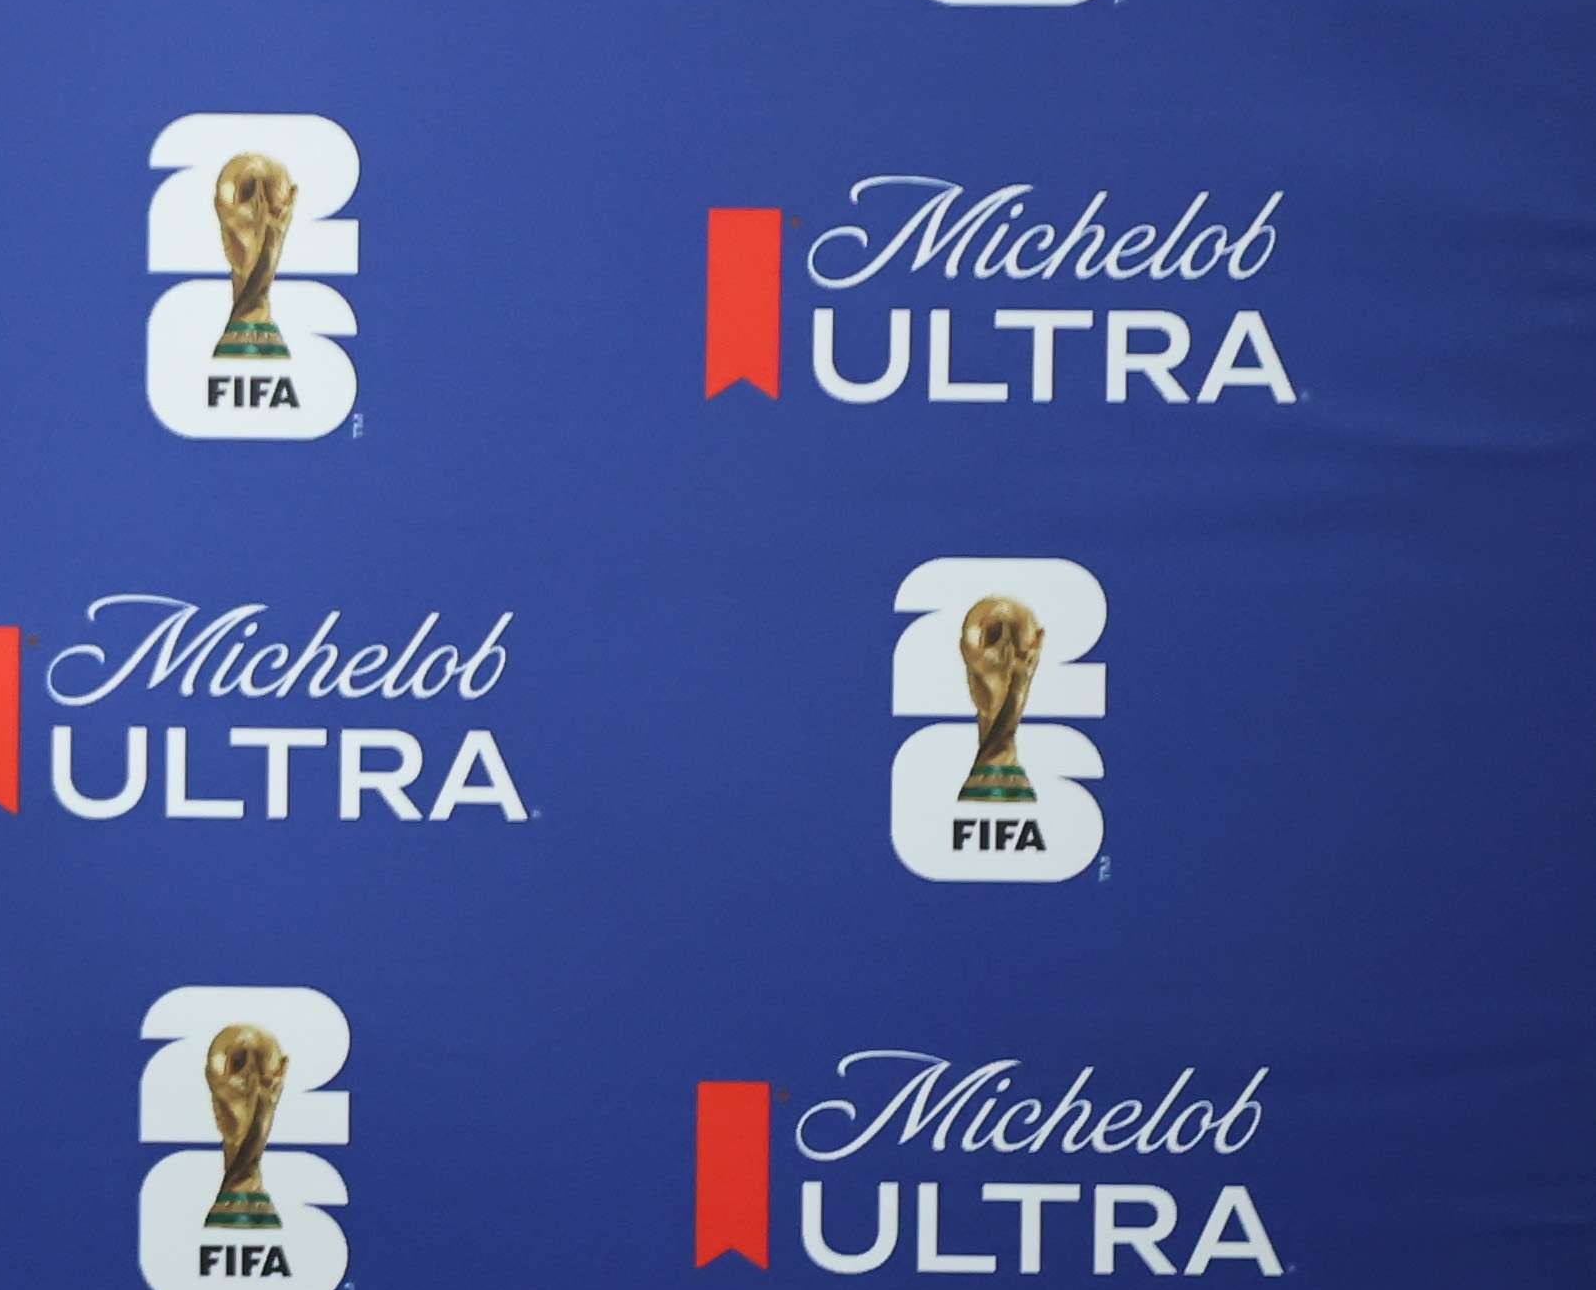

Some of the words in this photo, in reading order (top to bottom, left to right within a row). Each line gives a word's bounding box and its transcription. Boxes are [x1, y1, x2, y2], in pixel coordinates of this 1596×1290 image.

[807, 176, 1283, 289] Michelob
[208, 377, 298, 407] FIFA
[812, 308, 1297, 404] ULTRA
[46, 594, 513, 706] Michelob
[51, 725, 528, 822] ULTRA
[953, 820, 1045, 850] FIFA
[795, 1050, 1269, 1161] Michelob
[200, 1246, 290, 1277] FIFA
[801, 1181, 1284, 1276] ULTRA
